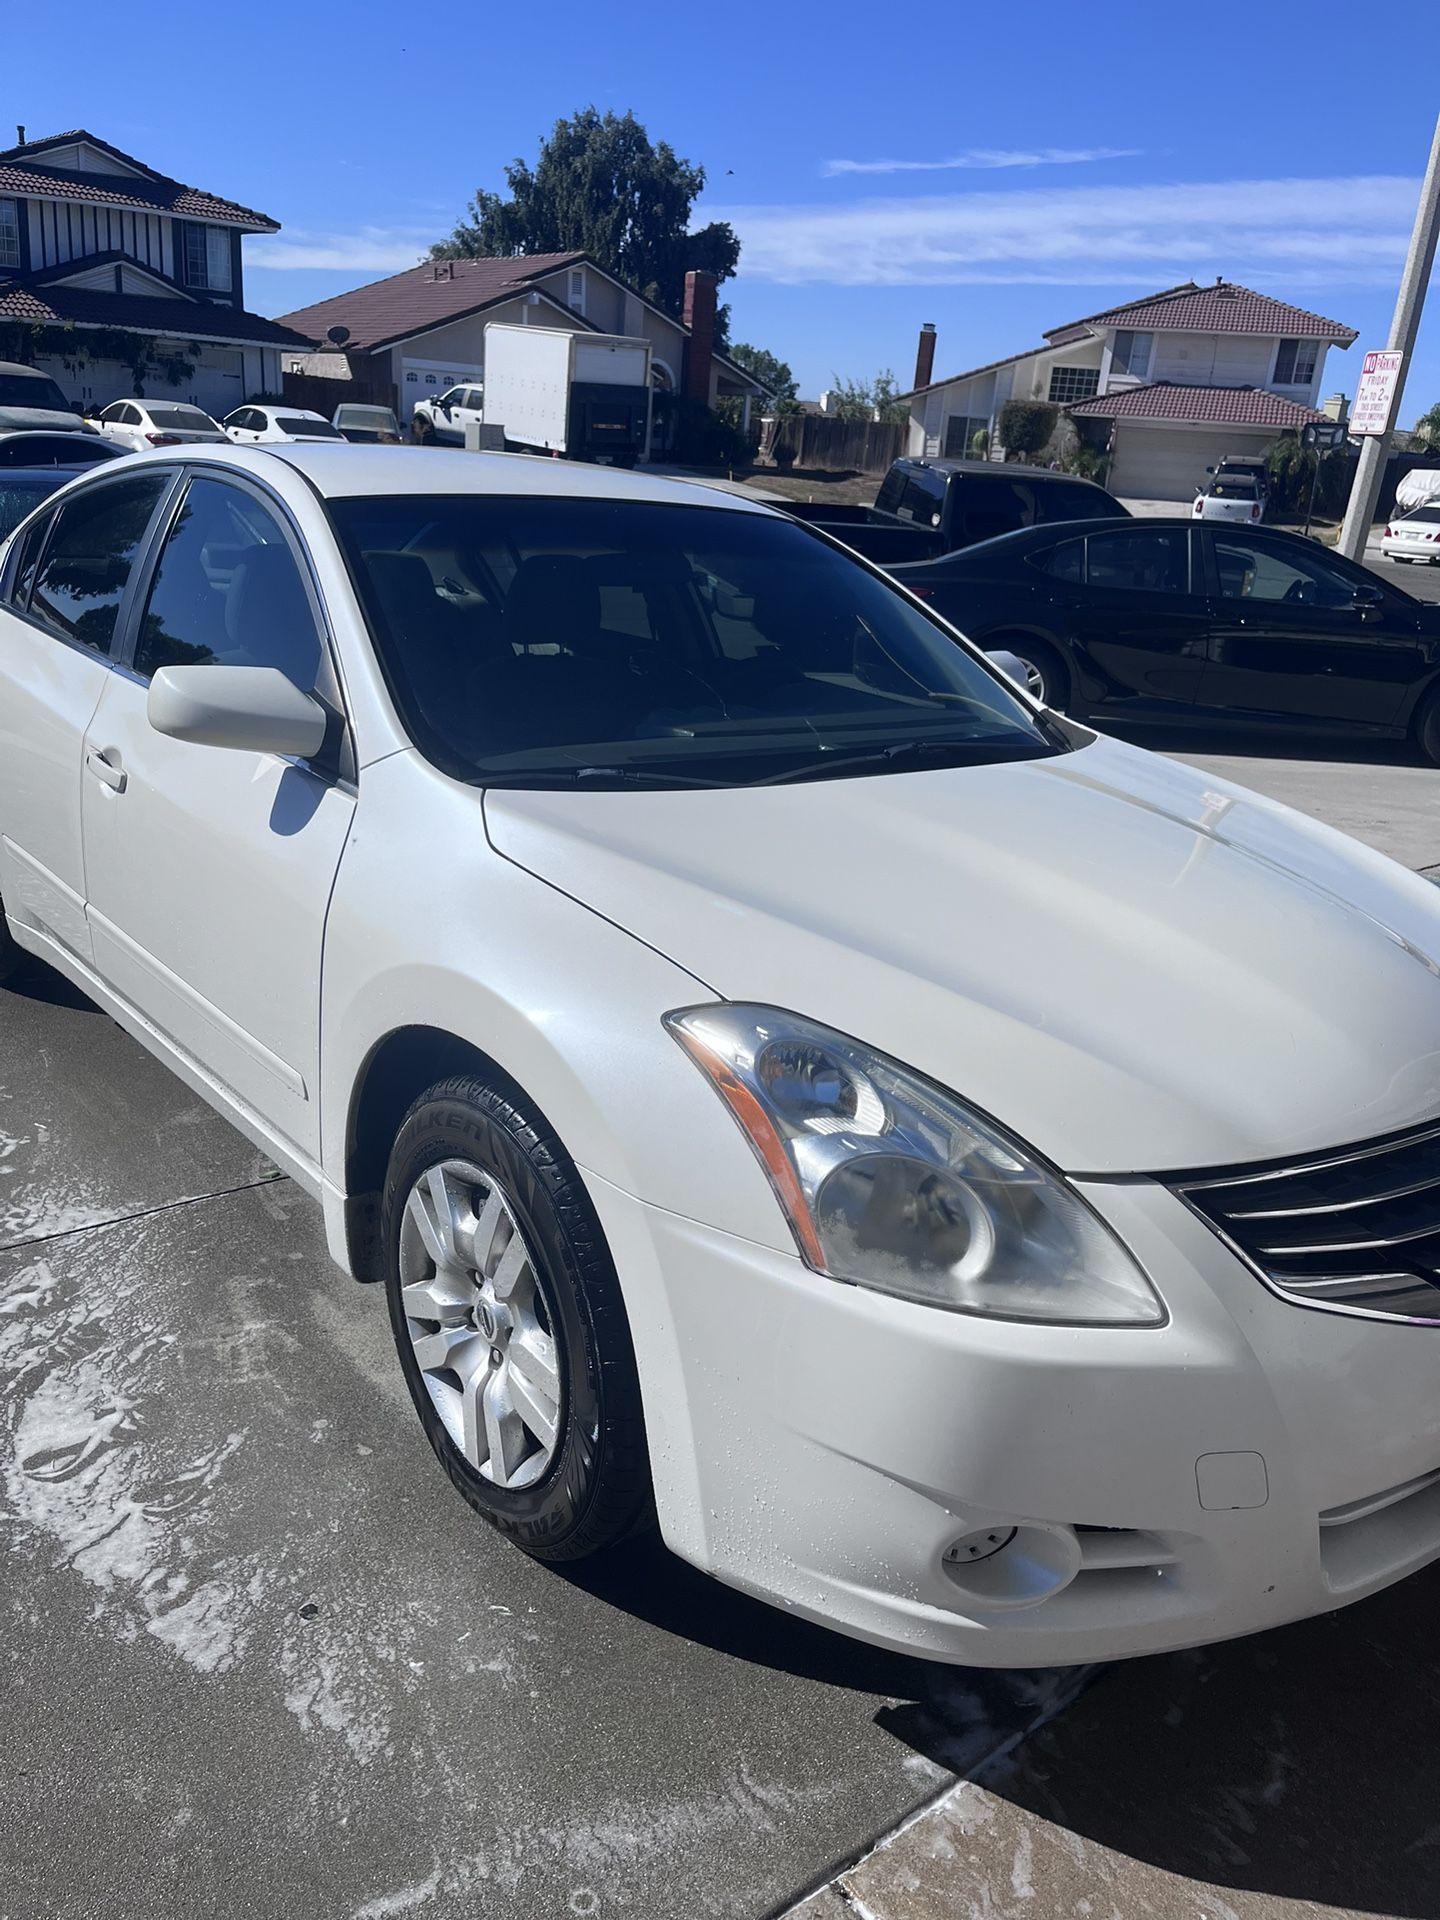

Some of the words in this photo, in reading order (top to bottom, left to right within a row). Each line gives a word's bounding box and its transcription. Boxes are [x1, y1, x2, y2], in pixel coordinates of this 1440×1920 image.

[1365, 355, 1377, 372] NO
[1377, 357, 1399, 370] PARKING
[1367, 376, 1388, 386] FRIDAY
[1369, 392, 1377, 401] TO
